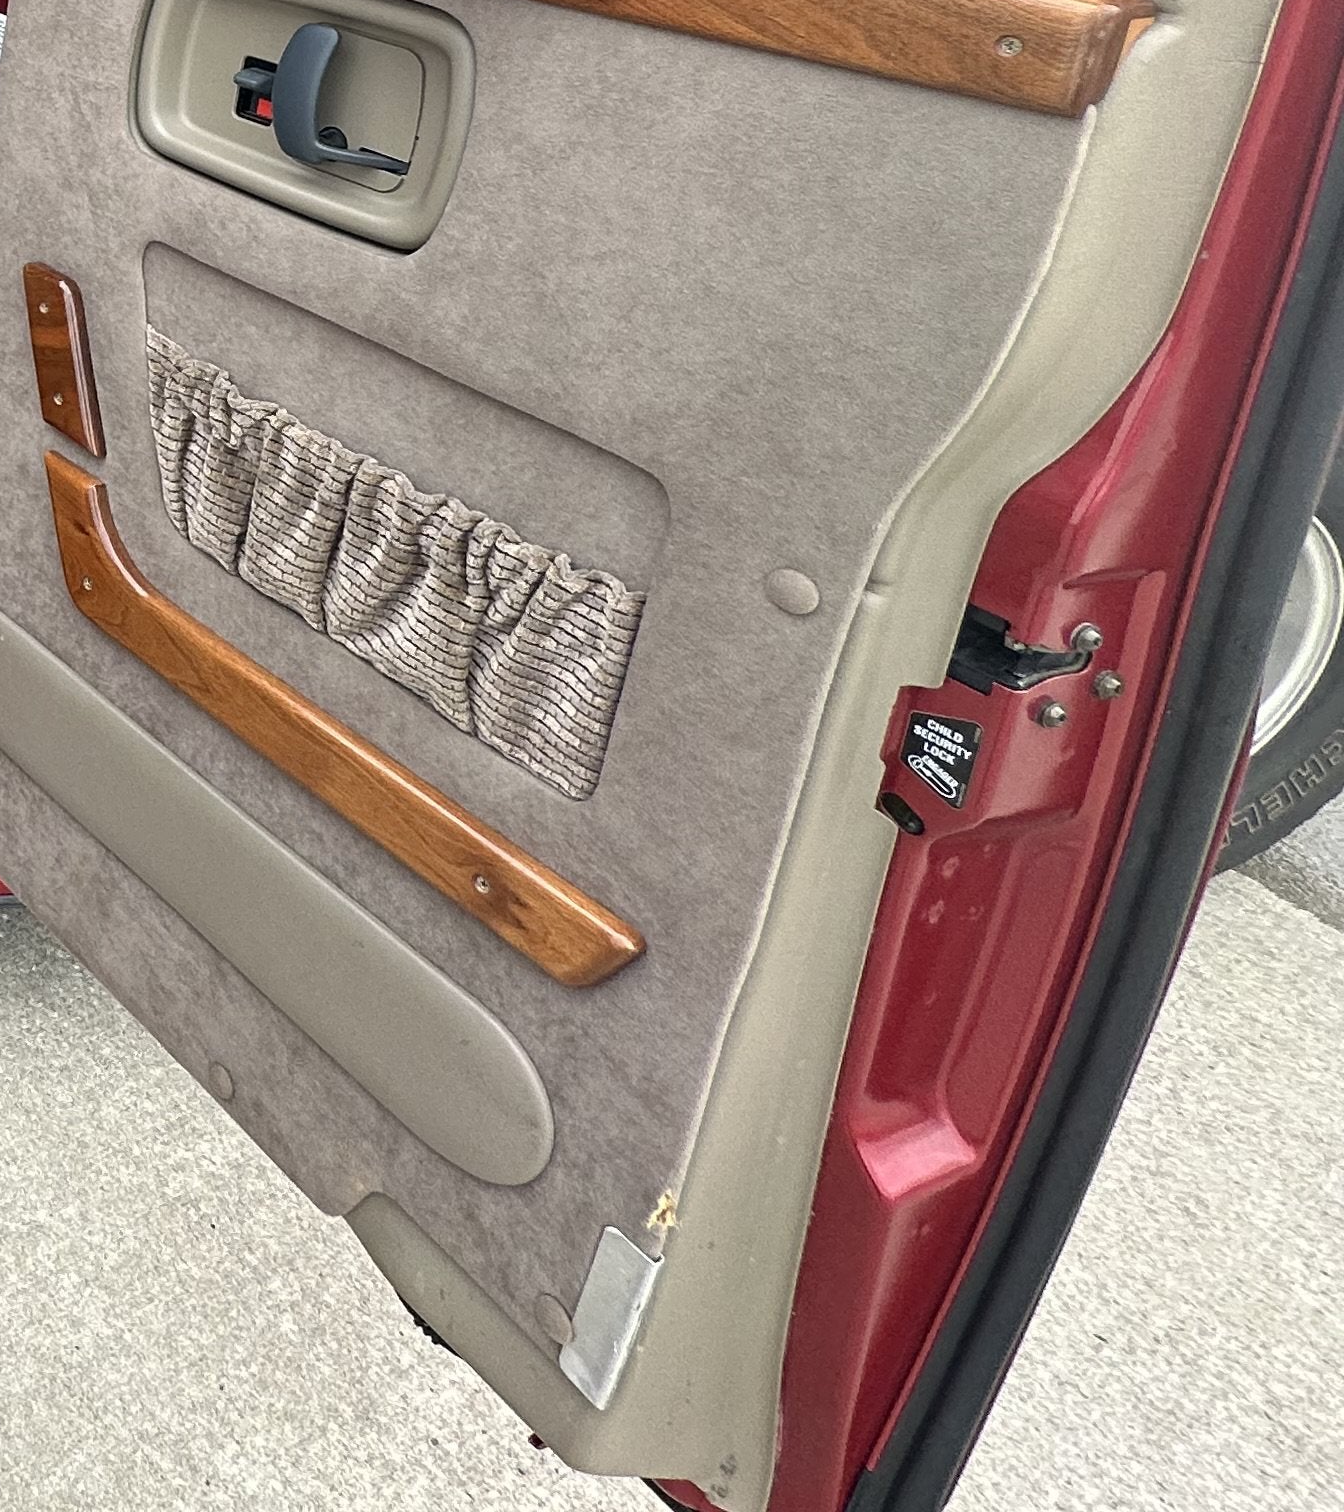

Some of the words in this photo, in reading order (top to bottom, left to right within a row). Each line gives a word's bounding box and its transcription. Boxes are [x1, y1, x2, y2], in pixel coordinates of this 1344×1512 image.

[913, 724, 973, 760] SECURITY
[927, 718, 964, 744] CHILD
[923, 741, 955, 766] LOCK
